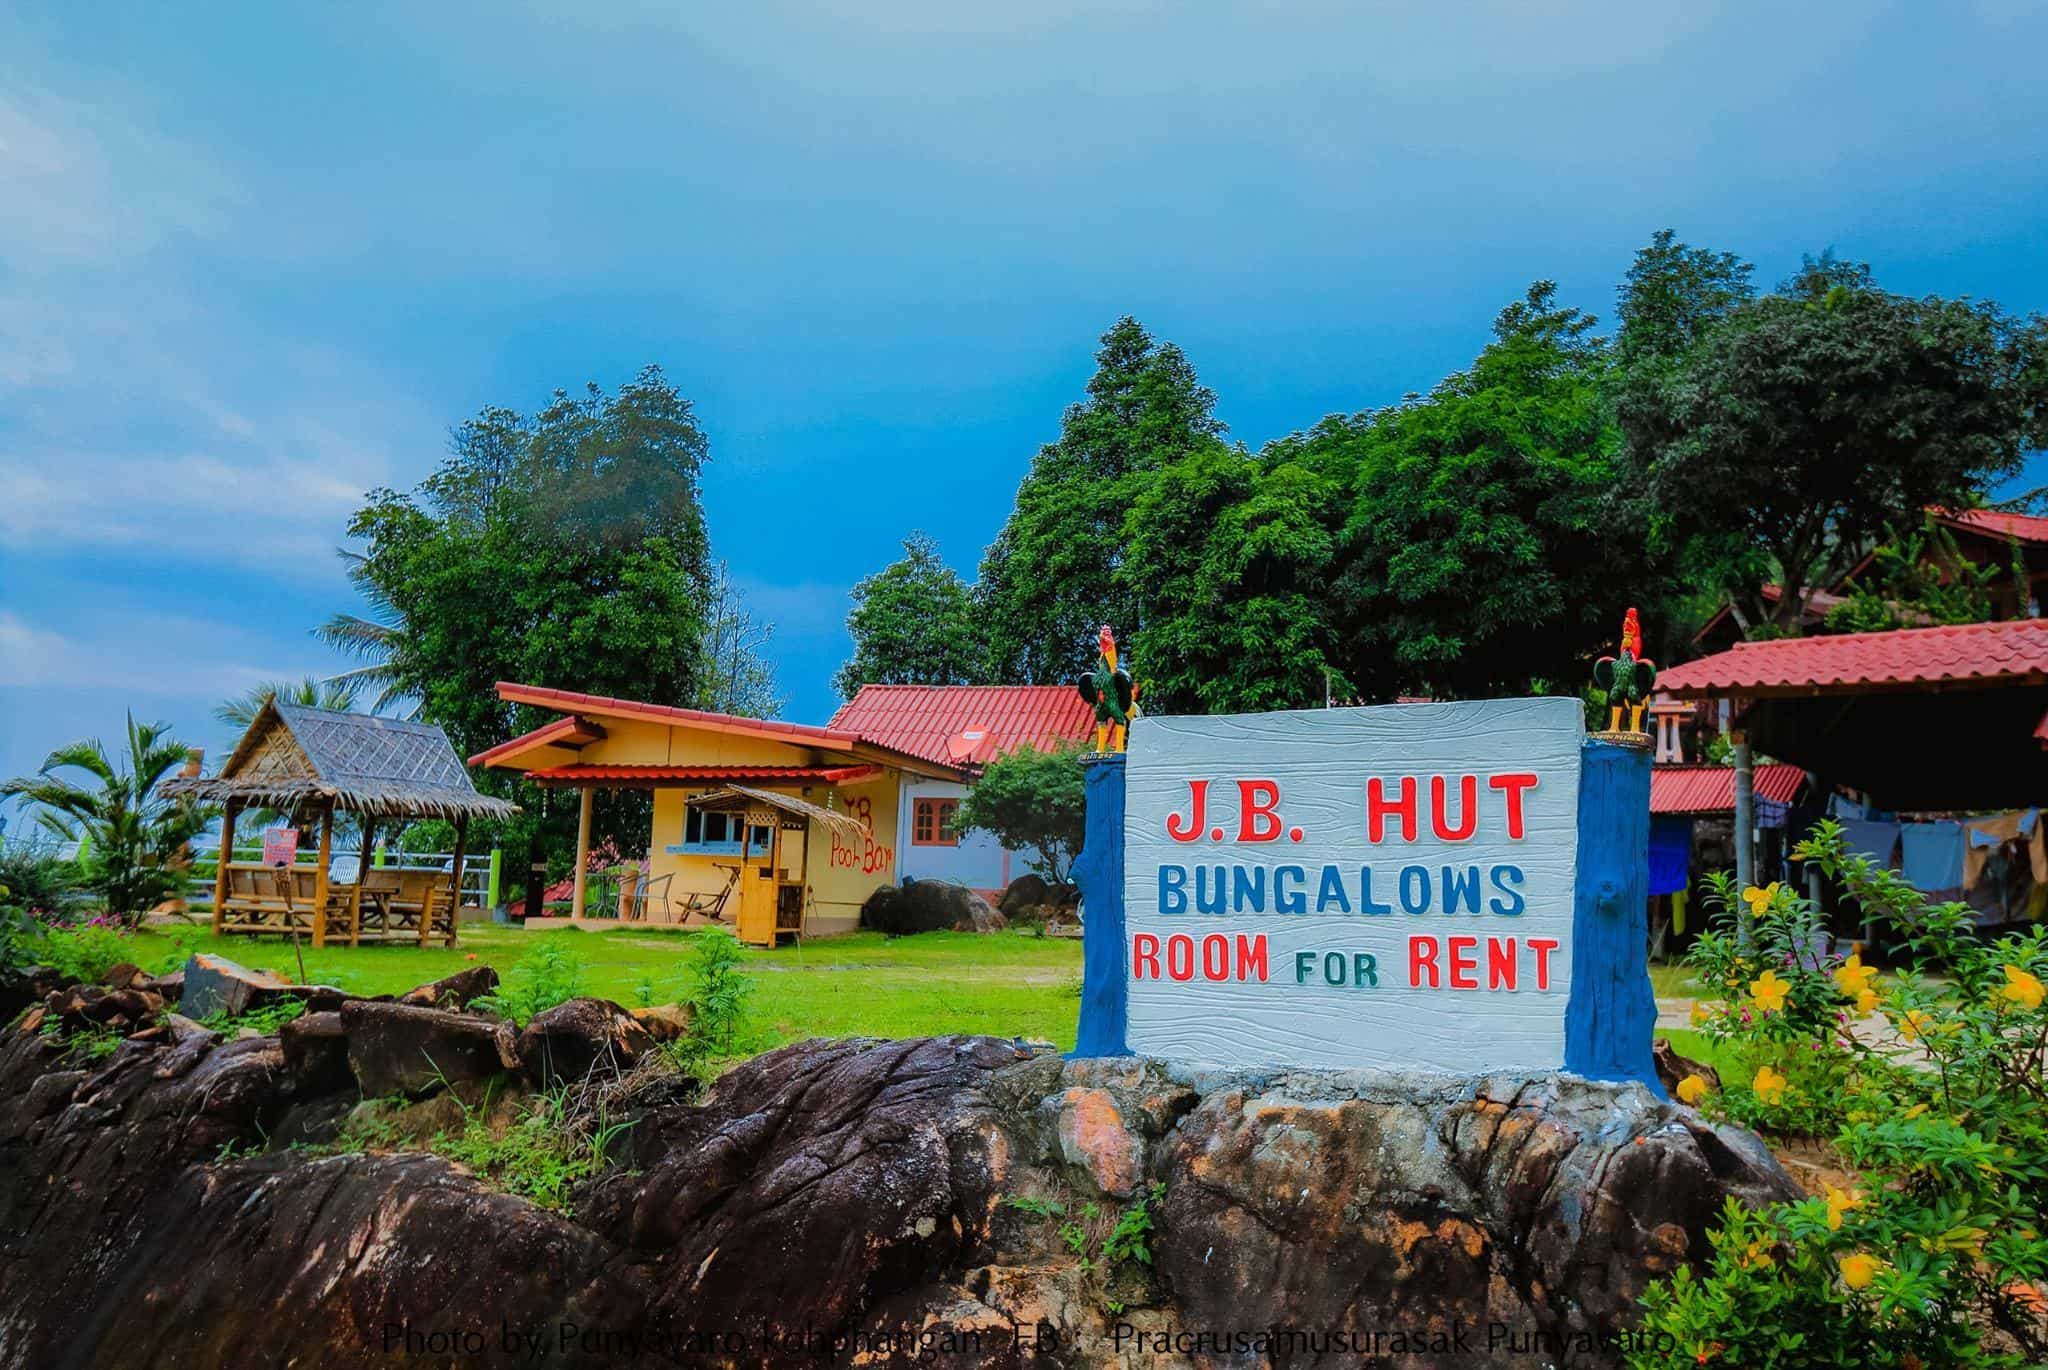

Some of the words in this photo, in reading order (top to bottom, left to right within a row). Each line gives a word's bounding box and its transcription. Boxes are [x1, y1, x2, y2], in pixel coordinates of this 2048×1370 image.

[1166, 779, 1304, 844] J.B.
[1366, 772, 1539, 844] HUT
[862, 837, 894, 874] Bar
[1157, 864, 1525, 916] BUNGALOWS
[1132, 933, 1269, 982] ROOM
[1295, 951, 1378, 987] FOR
[1408, 935, 1559, 991] RENT
